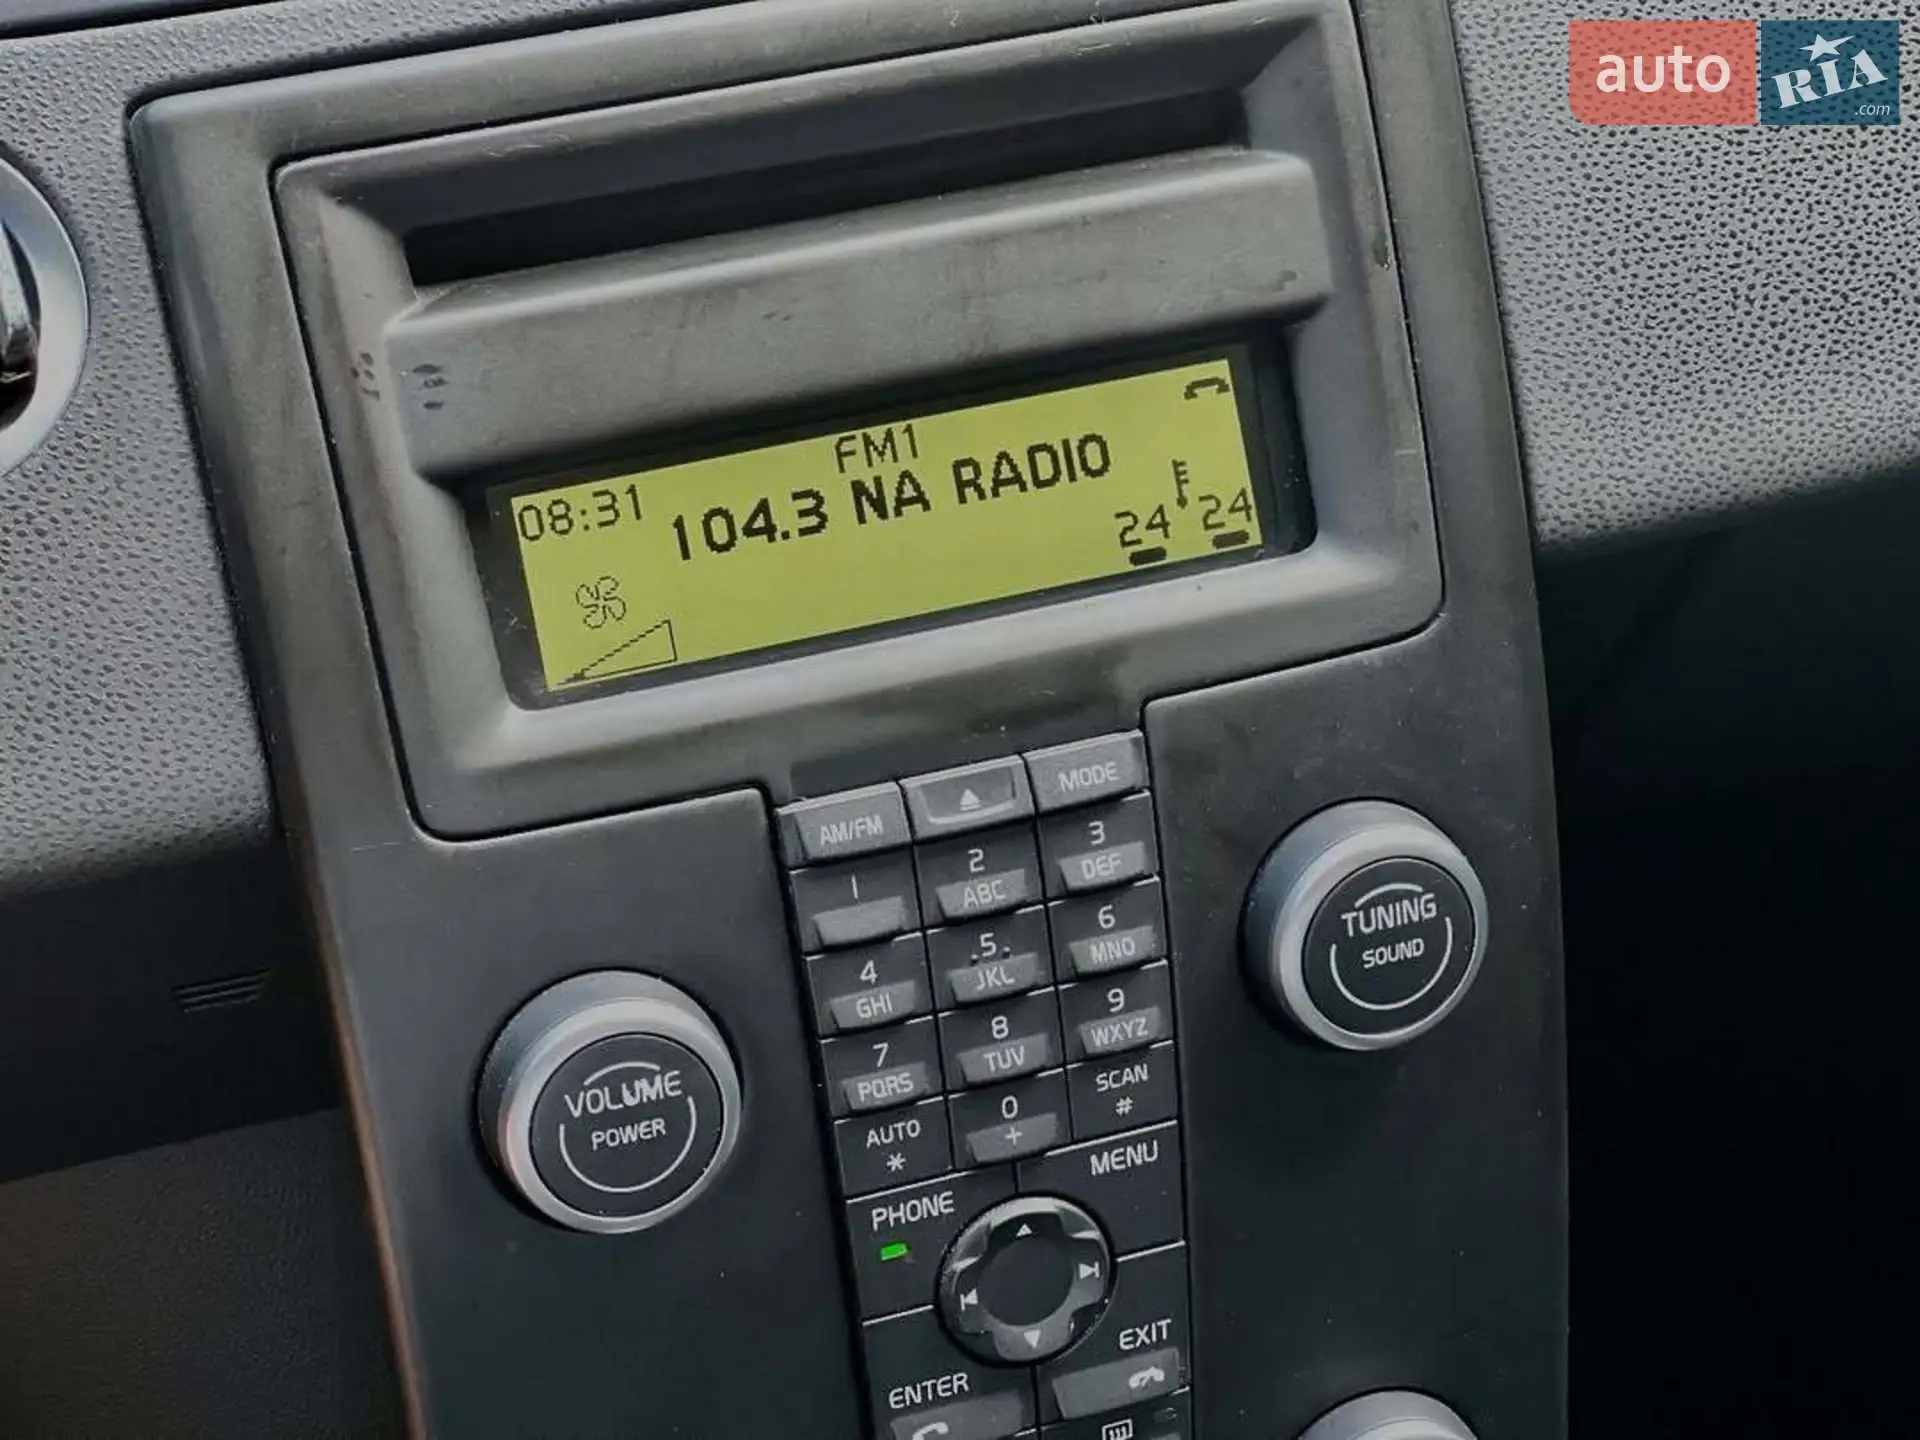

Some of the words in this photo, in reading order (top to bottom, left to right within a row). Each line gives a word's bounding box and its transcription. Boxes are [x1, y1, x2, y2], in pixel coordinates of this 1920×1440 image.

[834, 423, 919, 474] FM1
[518, 483, 643, 541] 08:31
[671, 488, 829, 561] 104.3
[850, 469, 932, 526] NA
[952, 433, 1111, 505] RADIO
[1114, 503, 1172, 548] 24
[1198, 486, 1253, 531] 24
[1058, 761, 1120, 792] MODE
[819, 814, 884, 846] AM/FM
[1087, 820, 1105, 846] 3
[967, 848, 985, 873] 2
[1080, 852, 1123, 879] DEF
[962, 879, 1006, 909] ABC
[1098, 904, 1116, 930] 6
[1340, 893, 1438, 938] TUNING
[1089, 937, 1136, 965] MNO
[1362, 937, 1425, 969] SOUND
[860, 959, 878, 985] 4
[975, 965, 1016, 992] JKL
[856, 992, 893, 1020] GHI
[1107, 987, 1125, 1013] 9
[991, 1015, 1010, 1040] 8
[1091, 1016, 1150, 1047] WXYZ
[872, 1043, 889, 1068] 7
[983, 1046, 1026, 1074] TUV
[858, 1071, 915, 1102] PQRS
[1096, 1063, 1150, 1093] SCAN
[564, 1070, 683, 1119] VOLUME
[591, 1117, 667, 1151] POWER
[866, 1119, 922, 1149] AUTO
[1089, 1140, 1160, 1176] MENU
[871, 1191, 956, 1232] PHONE
[1118, 1318, 1173, 1351] EXIT
[888, 1372, 970, 1410] ENTER
